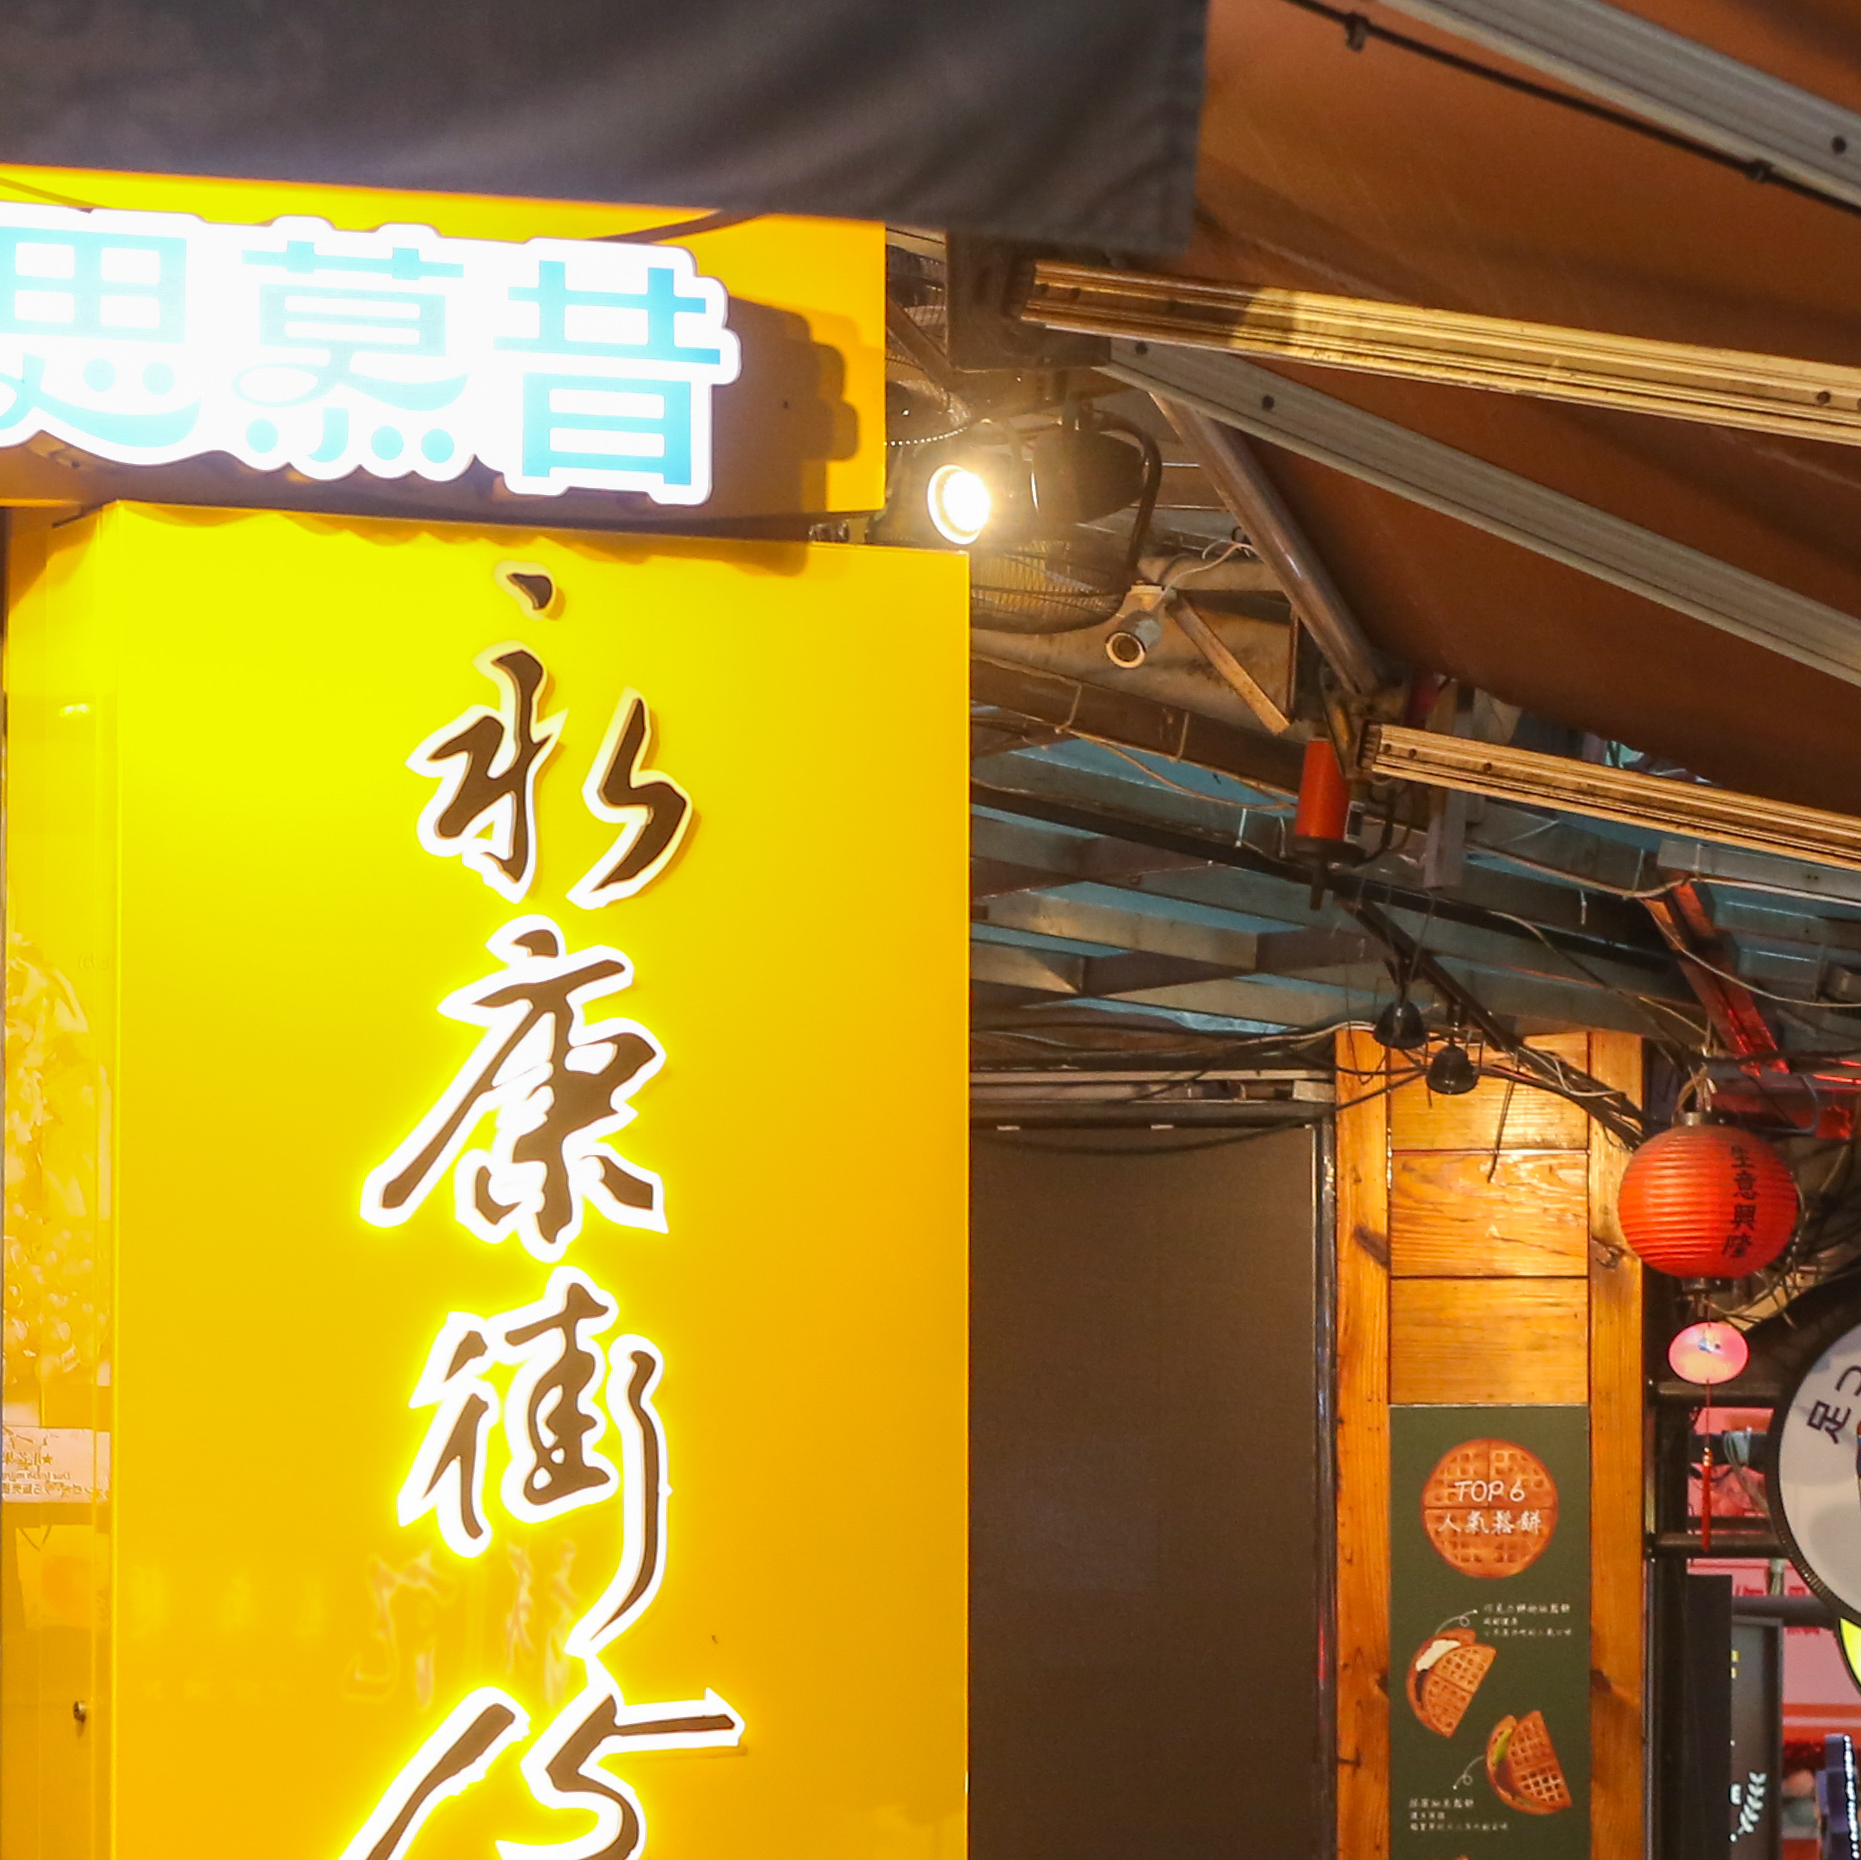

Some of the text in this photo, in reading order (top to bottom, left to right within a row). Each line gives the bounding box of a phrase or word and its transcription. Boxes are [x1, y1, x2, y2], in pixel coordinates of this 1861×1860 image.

[1453, 1479, 1526, 1503] TOP 6
[1437, 1509, 1542, 1537] 人氣鬆餅
